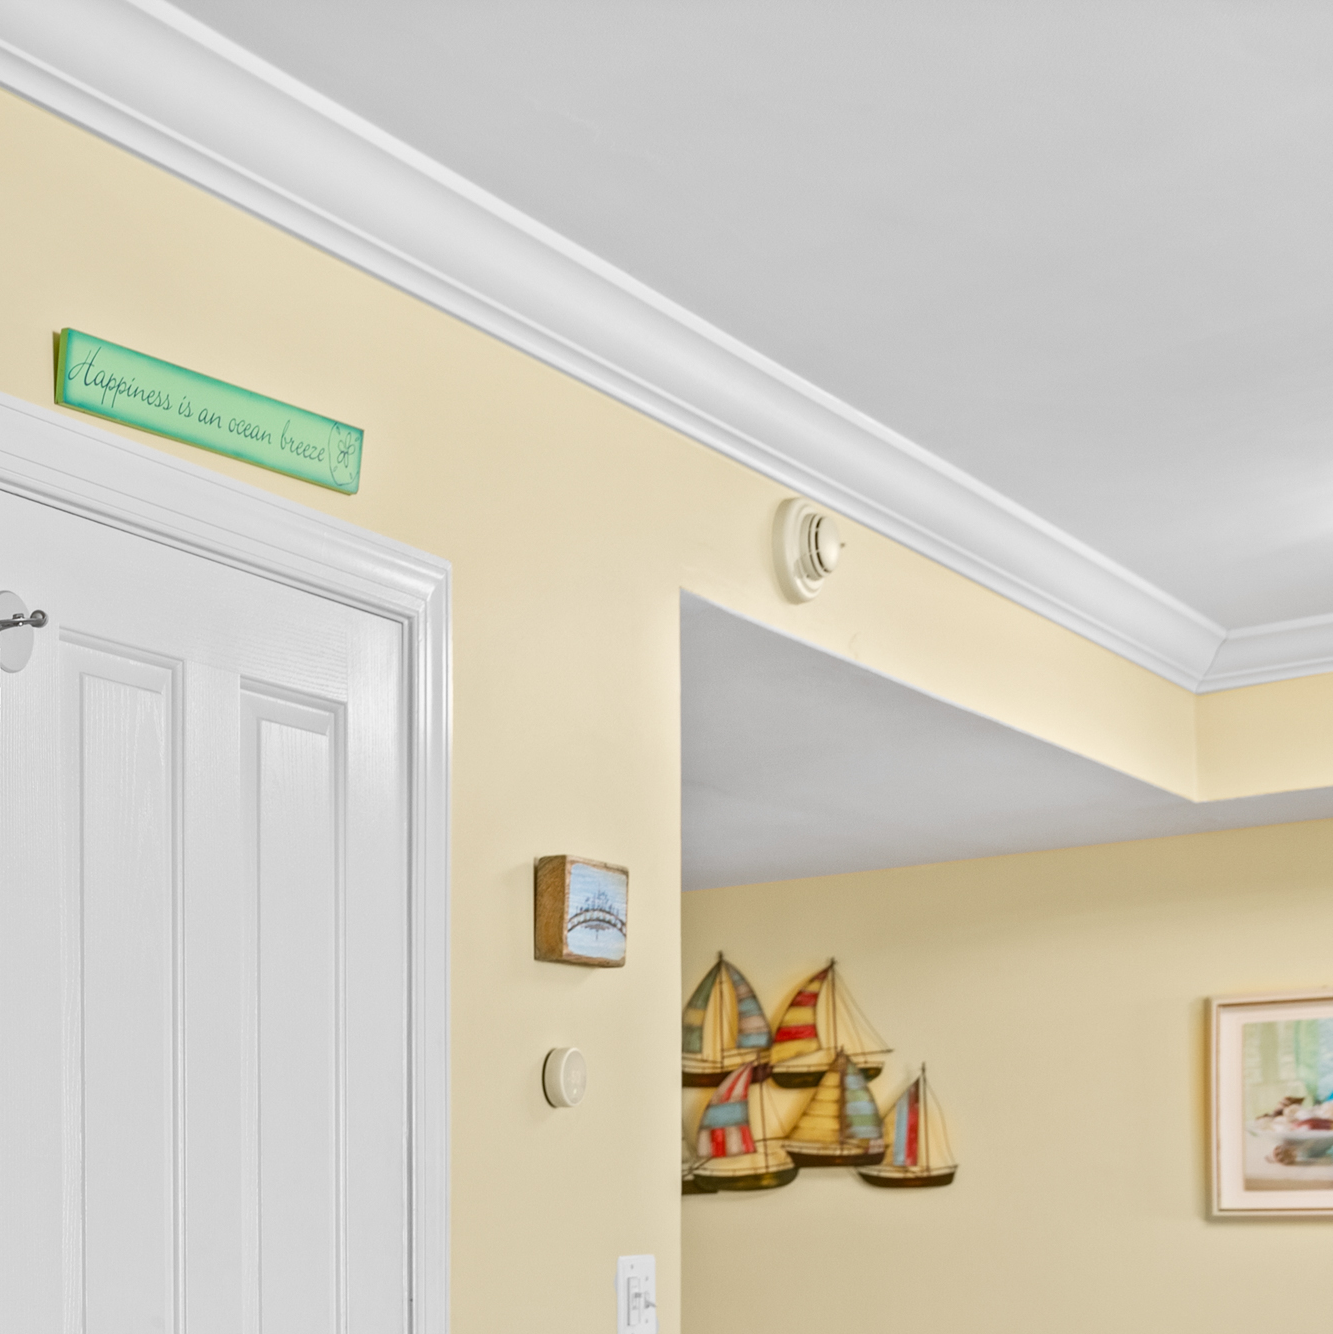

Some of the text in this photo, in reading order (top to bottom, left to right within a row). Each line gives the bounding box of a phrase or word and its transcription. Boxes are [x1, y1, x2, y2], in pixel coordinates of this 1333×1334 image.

[67, 346, 326, 462] Happiness is an ocean breeze
